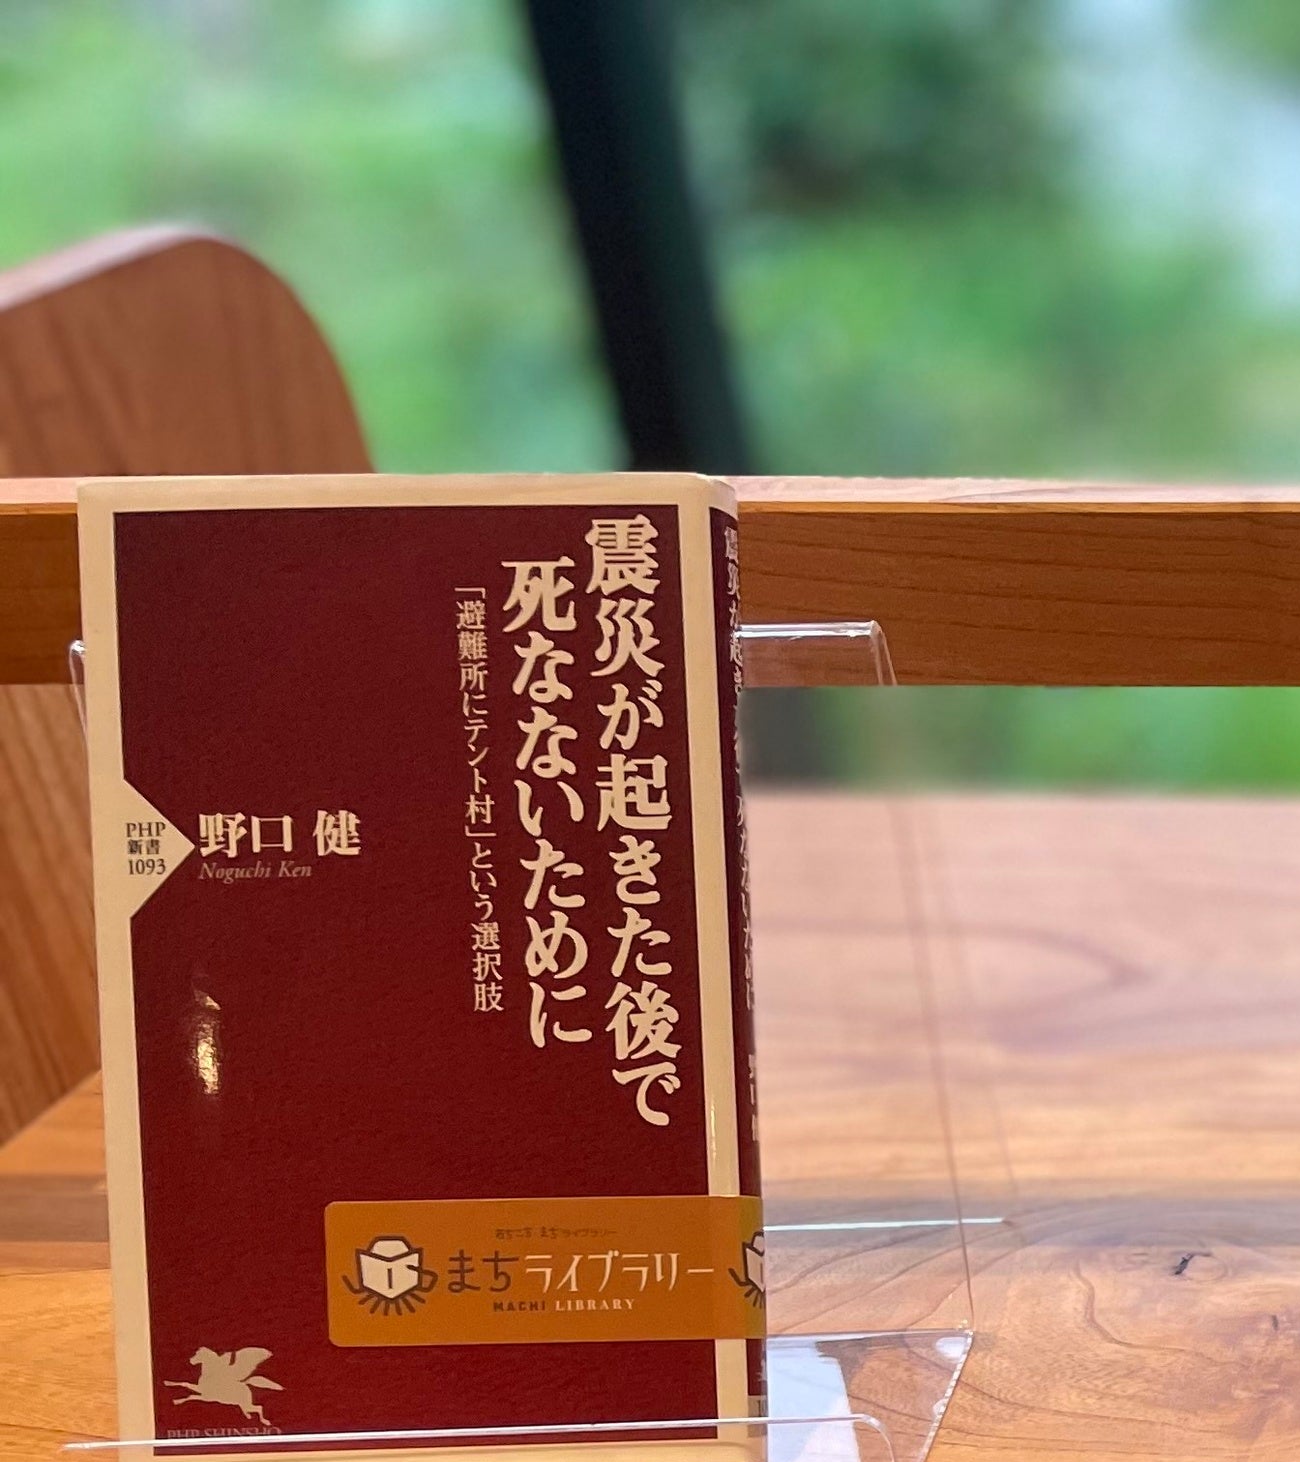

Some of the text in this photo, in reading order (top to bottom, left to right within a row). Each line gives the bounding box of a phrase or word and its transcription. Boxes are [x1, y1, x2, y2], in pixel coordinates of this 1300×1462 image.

[454, 585, 504, 1012] 「避難所にテント村」という選択肢
[501, 556, 592, 1048] 死なないために
[125, 822, 166, 838] PHP
[198, 810, 362, 858] 野口 健
[586, 514, 682, 1127] 震災が起きた後で
[127, 840, 161, 855] 新書
[127, 859, 166, 875] 1093
[198, 861, 313, 884] Noguchi Ken
[447, 1249, 715, 1293] まちライブラリー
[493, 1299, 635, 1312] MACHI LIBRARY
